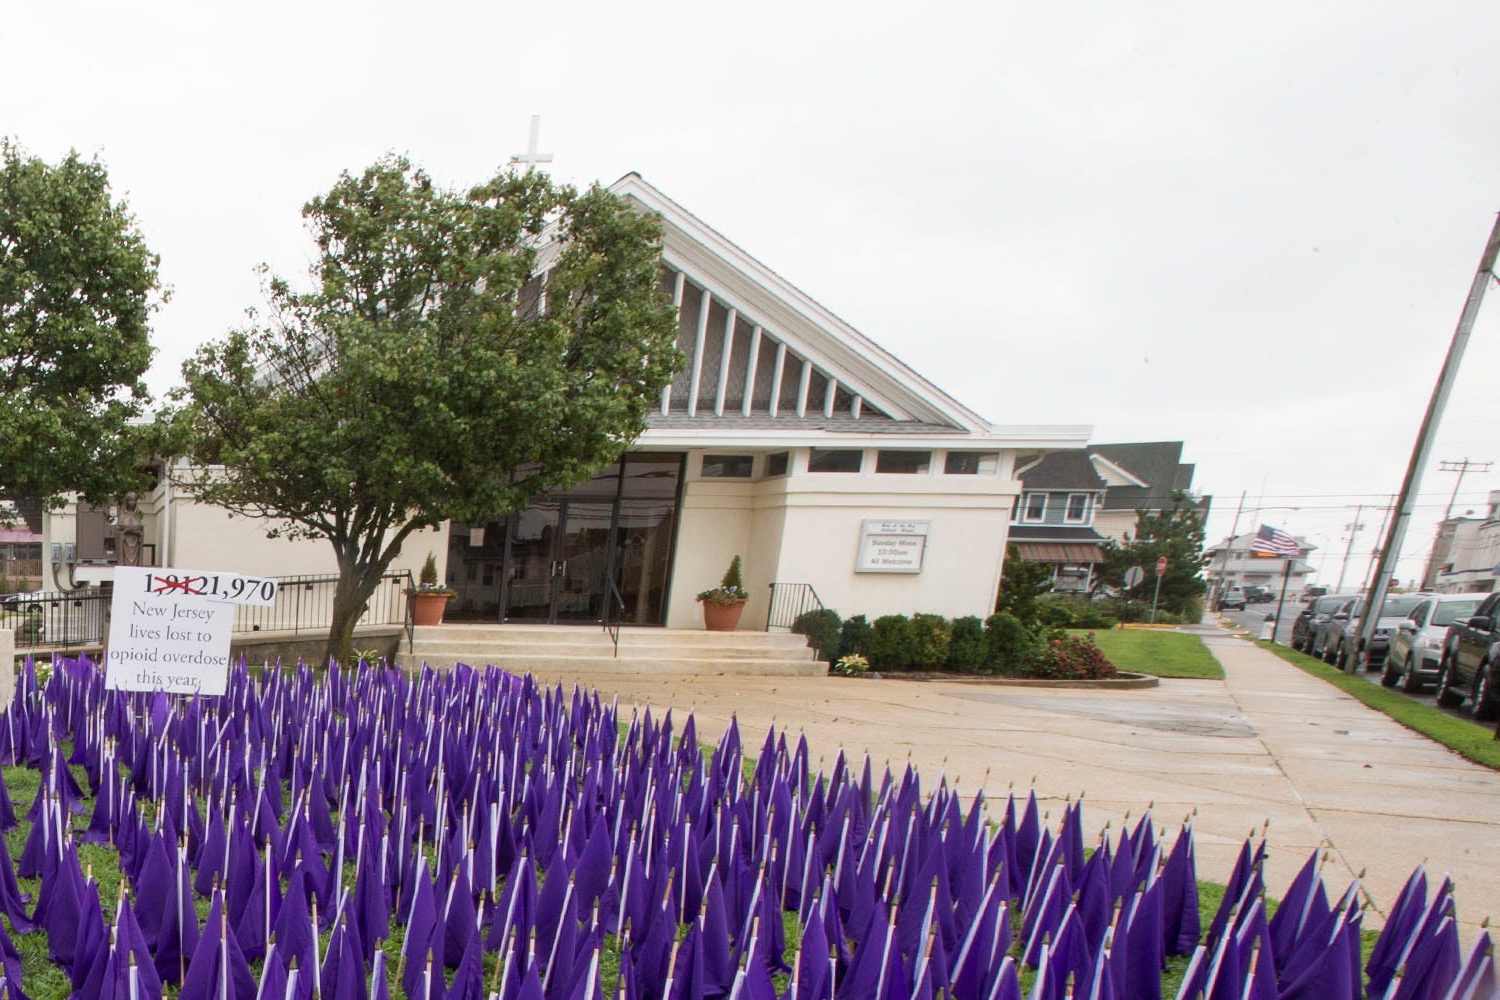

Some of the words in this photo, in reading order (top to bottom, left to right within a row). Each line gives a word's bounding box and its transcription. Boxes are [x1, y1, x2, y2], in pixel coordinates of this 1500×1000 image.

[132, 601, 168, 617] New
[170, 603, 215, 624] Jersey
[129, 624, 161, 640] lives
[166, 625, 193, 642] lost
[197, 631, 212, 643] to
[110, 647, 159, 665] opioid
[163, 650, 228, 666] overdose
[137, 669, 163, 686] this
